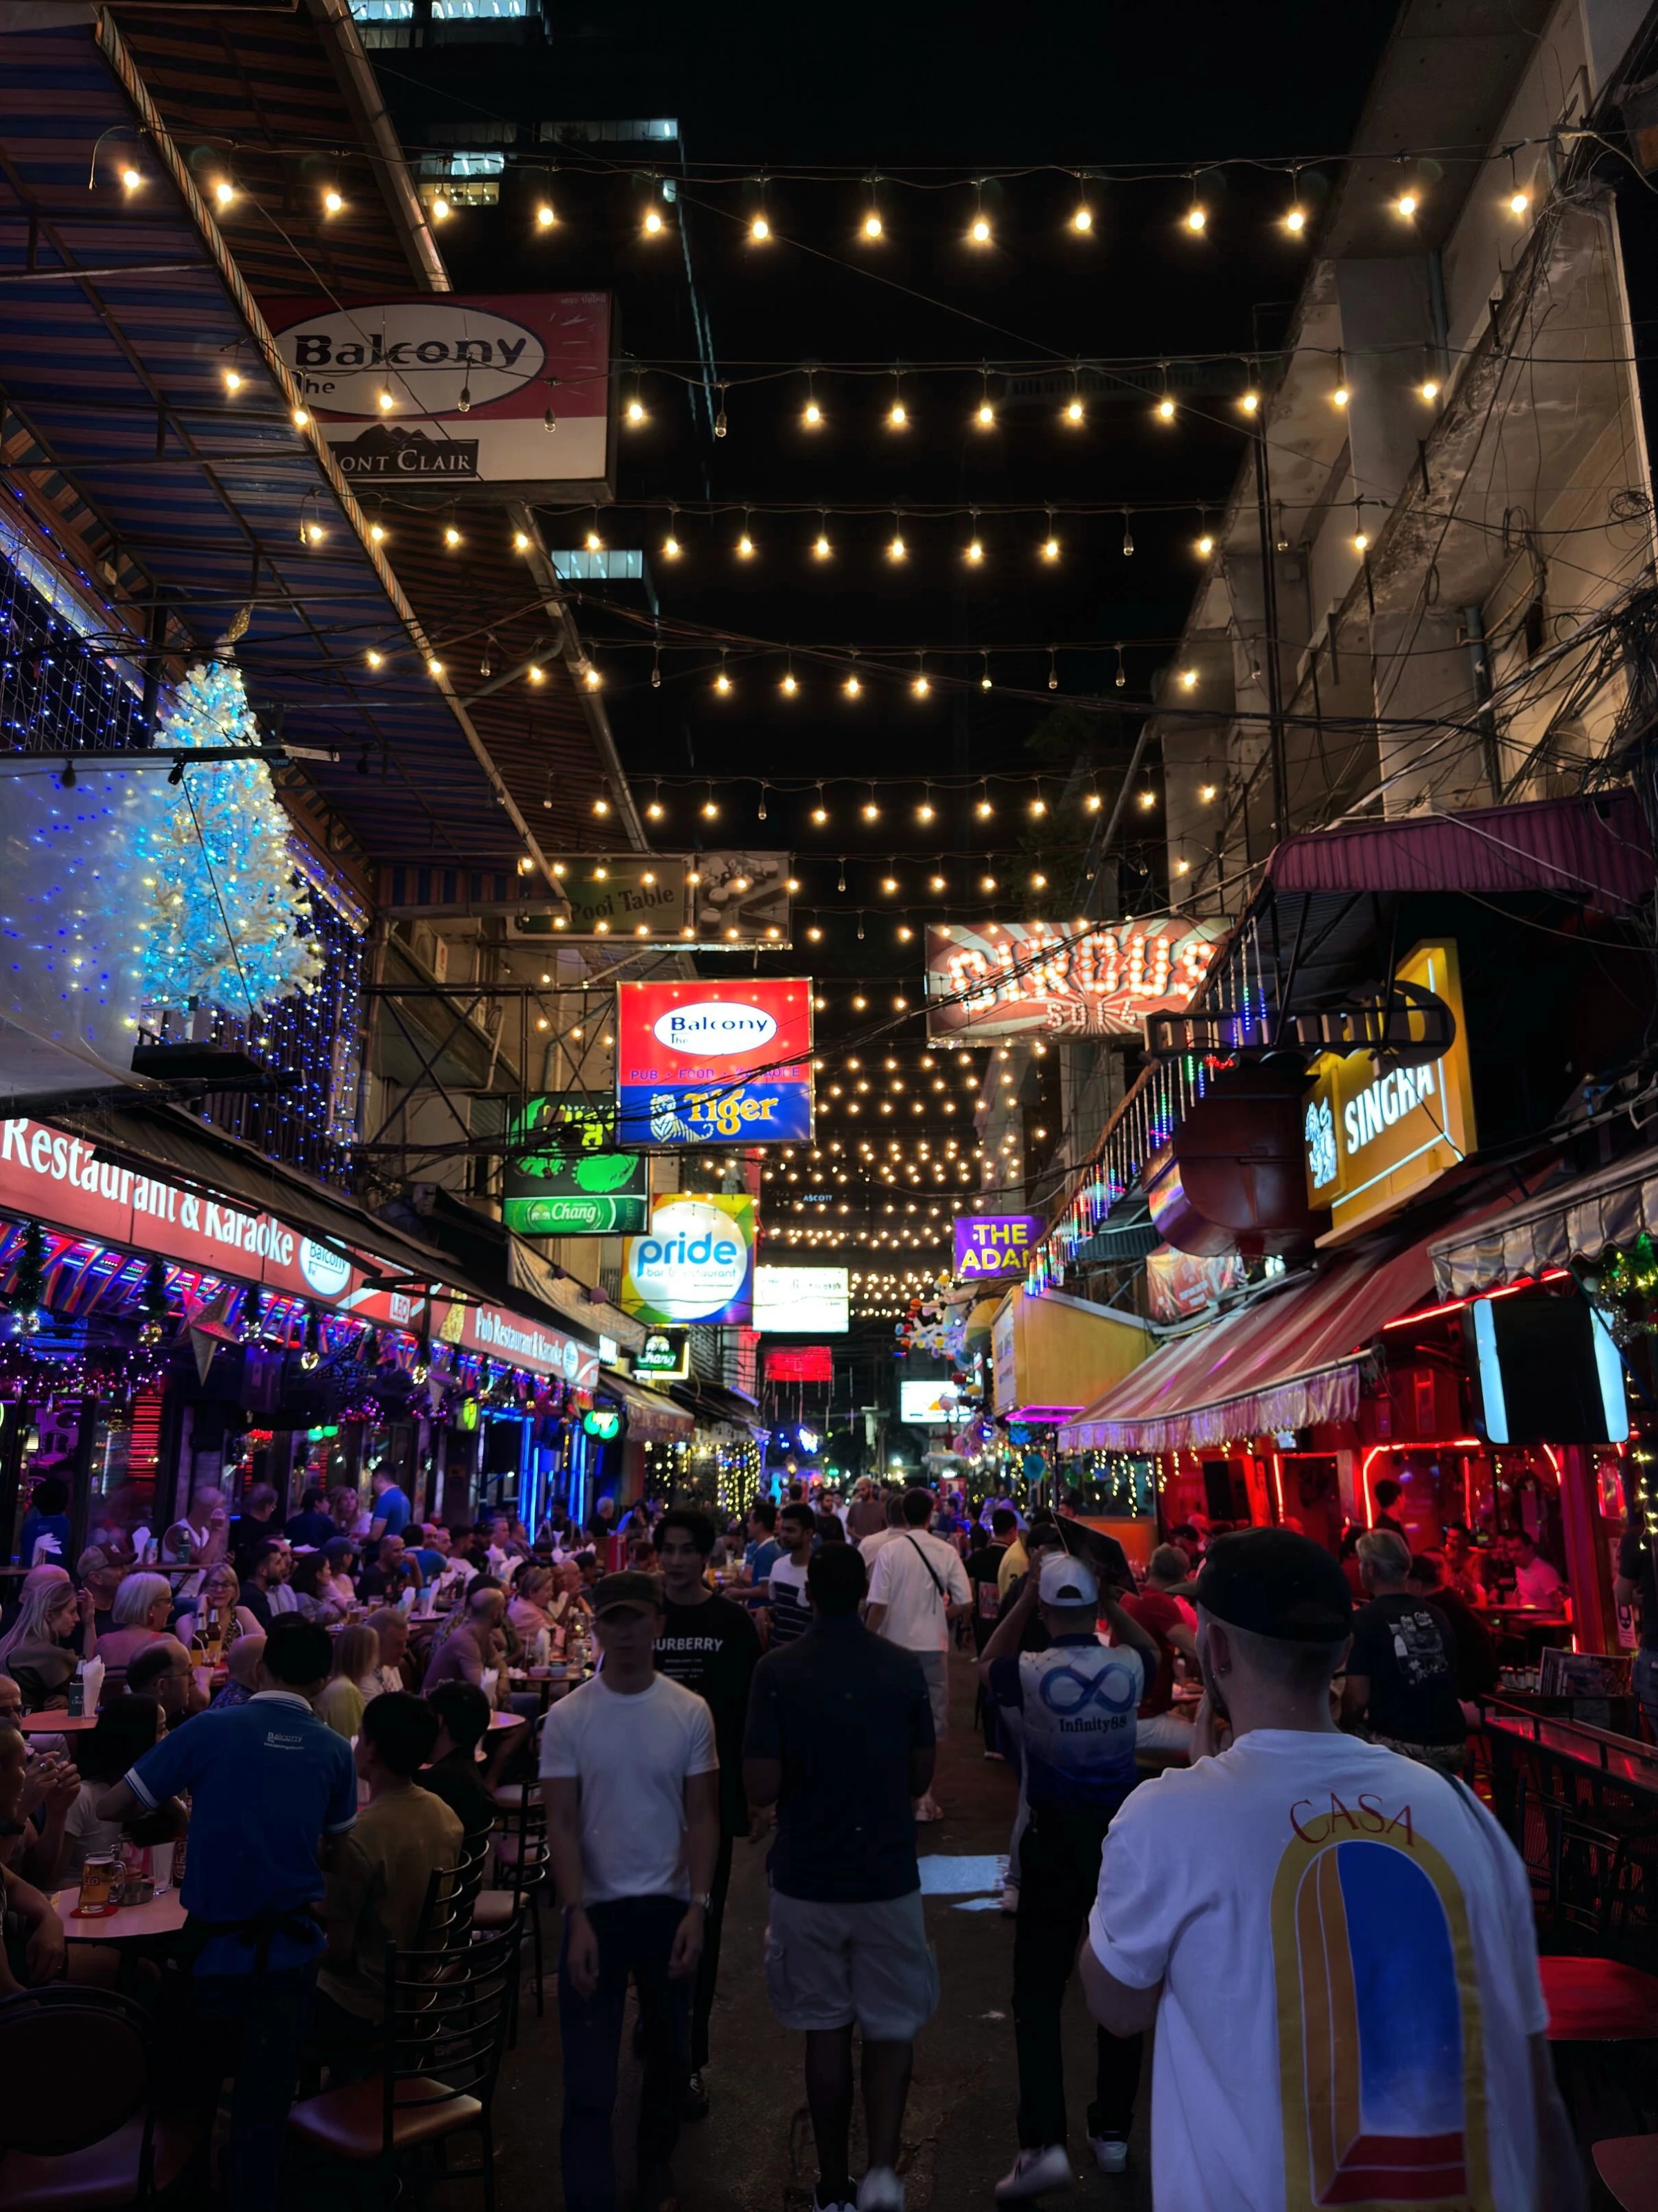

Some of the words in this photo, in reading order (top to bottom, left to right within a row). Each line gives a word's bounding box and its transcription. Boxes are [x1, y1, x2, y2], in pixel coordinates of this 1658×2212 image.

[294, 335, 527, 367] Balcony
[332, 451, 389, 472] ONT
[570, 894, 614, 922] Pool
[618, 885, 674, 912] Table
[950, 932, 1217, 1013] CIRCUS
[670, 1017, 768, 1032] Balcony
[1047, 1002, 1106, 1027] SOI
[1120, 1000, 1137, 1025] 4
[670, 1033, 688, 1044] The
[630, 1070, 658, 1080] PUB
[679, 1069, 715, 1079] FOOD
[735, 1067, 800, 1078] KAAOKE
[684, 1088, 779, 1135] Tiger
[1345, 1065, 1435, 1154] SINGHA
[1, 1118, 178, 1222] Restaurant
[180, 1193, 200, 1231] &
[205, 1201, 293, 1266] Karaoke
[803, 1194, 833, 1202] ASCOTT
[552, 1203, 596, 1223] Chang
[974, 1224, 1028, 1244] THE
[637, 1231, 737, 1278] pride
[647, 1267, 663, 1277] bar
[683, 1268, 736, 1277] rstaurant
[393, 1295, 409, 1321] LEO
[475, 1307, 493, 1342] Pub
[493, 1314, 532, 1356] Restaurant
[1290, 1792, 1415, 1846] CASA
